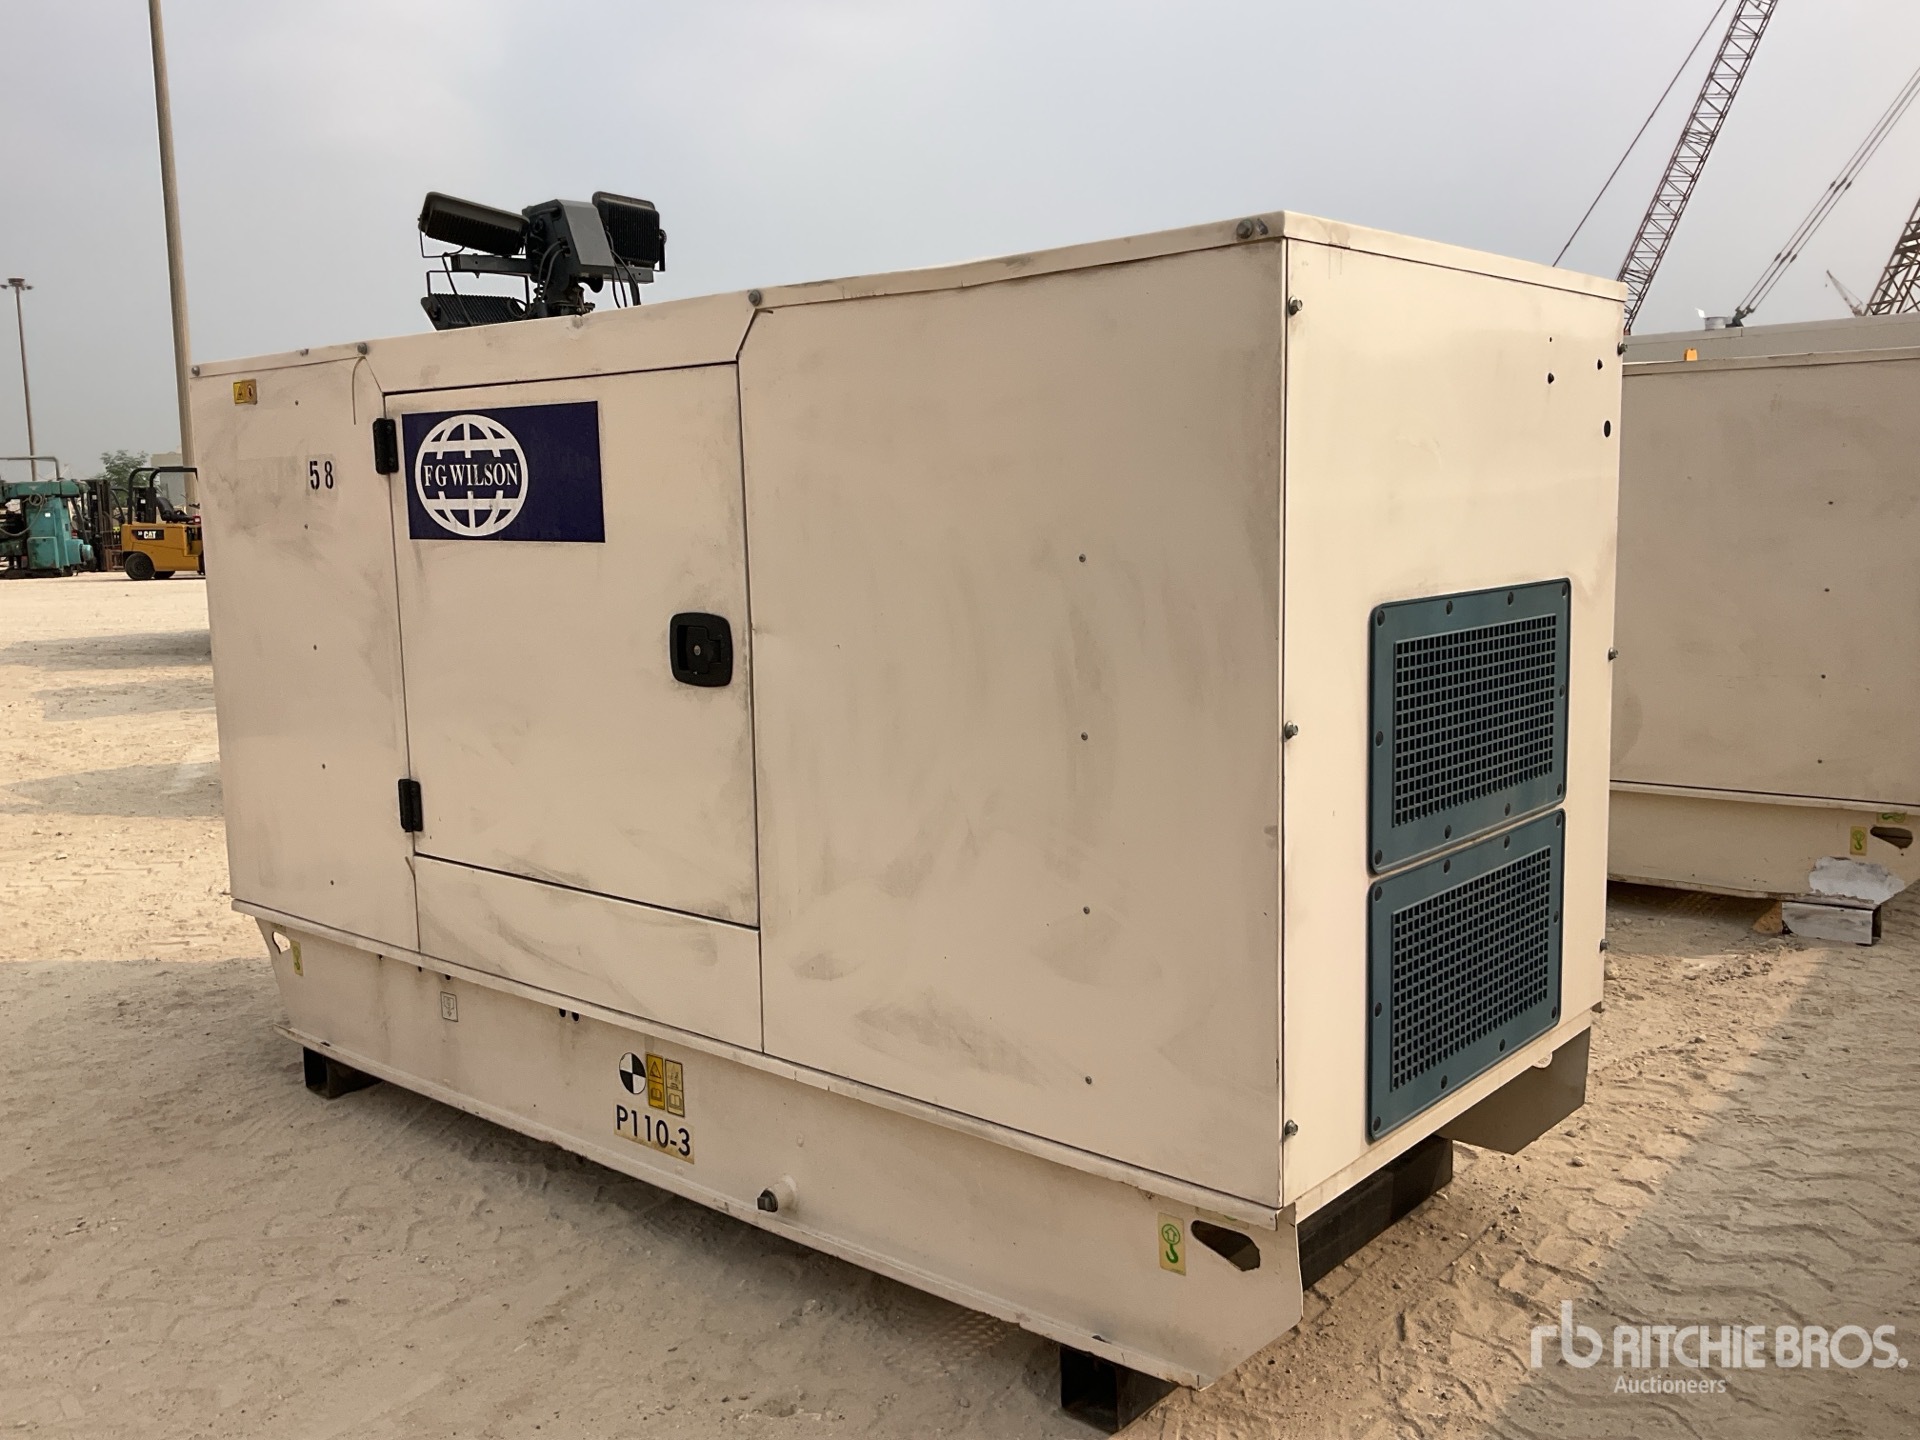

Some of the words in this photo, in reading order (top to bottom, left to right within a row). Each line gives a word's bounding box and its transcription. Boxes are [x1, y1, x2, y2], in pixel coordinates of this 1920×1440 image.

[449, 462, 518, 486] WILSON
[143, 530, 157, 539] CAT
[616, 1104, 691, 1156] P110-3
